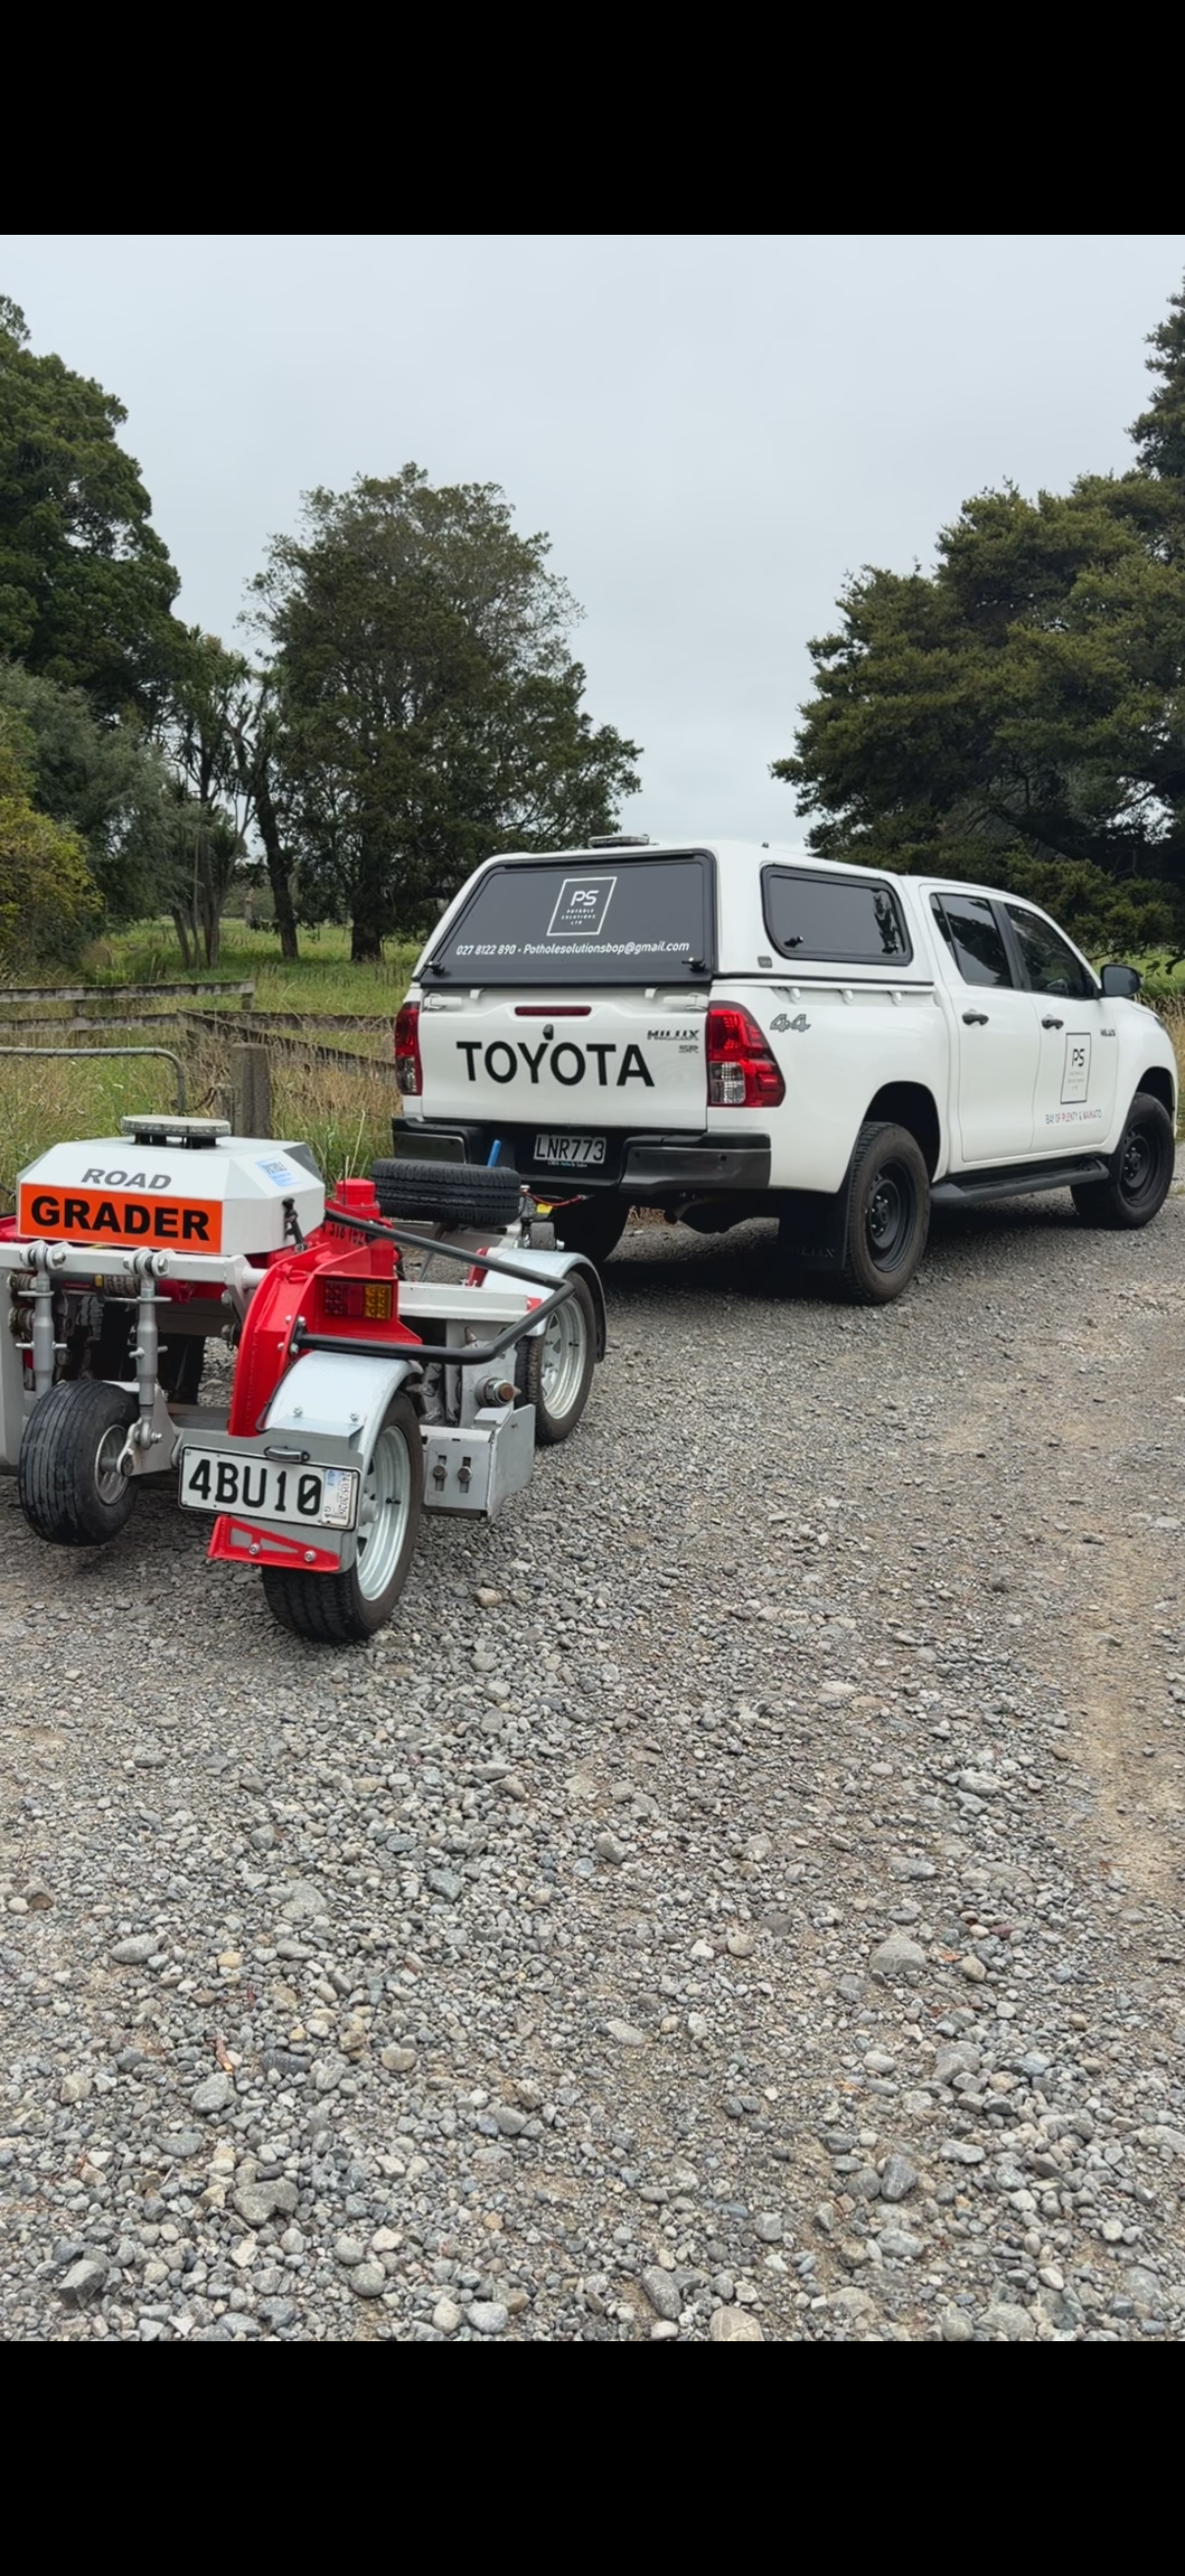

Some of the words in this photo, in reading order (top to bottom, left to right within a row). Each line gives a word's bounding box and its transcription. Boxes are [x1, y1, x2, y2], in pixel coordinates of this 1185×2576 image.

[571, 890, 599, 906] PS
[456, 945, 474, 955] 027
[475, 944, 496, 955] 8122
[497, 944, 516, 955] 890
[523, 941, 690, 955] Potholesolutionsbop@gmail.com
[648, 1030, 700, 1040] HILUX
[678, 1044, 699, 1053] SR
[1071, 1048, 1085, 1067] PS
[456, 1040, 655, 1087] TOYOTA
[536, 1137, 605, 1161] LNR773
[81, 1168, 172, 1190] ROAD
[30, 1195, 210, 1242] GRADER
[189, 1458, 322, 1516] 4BU10
